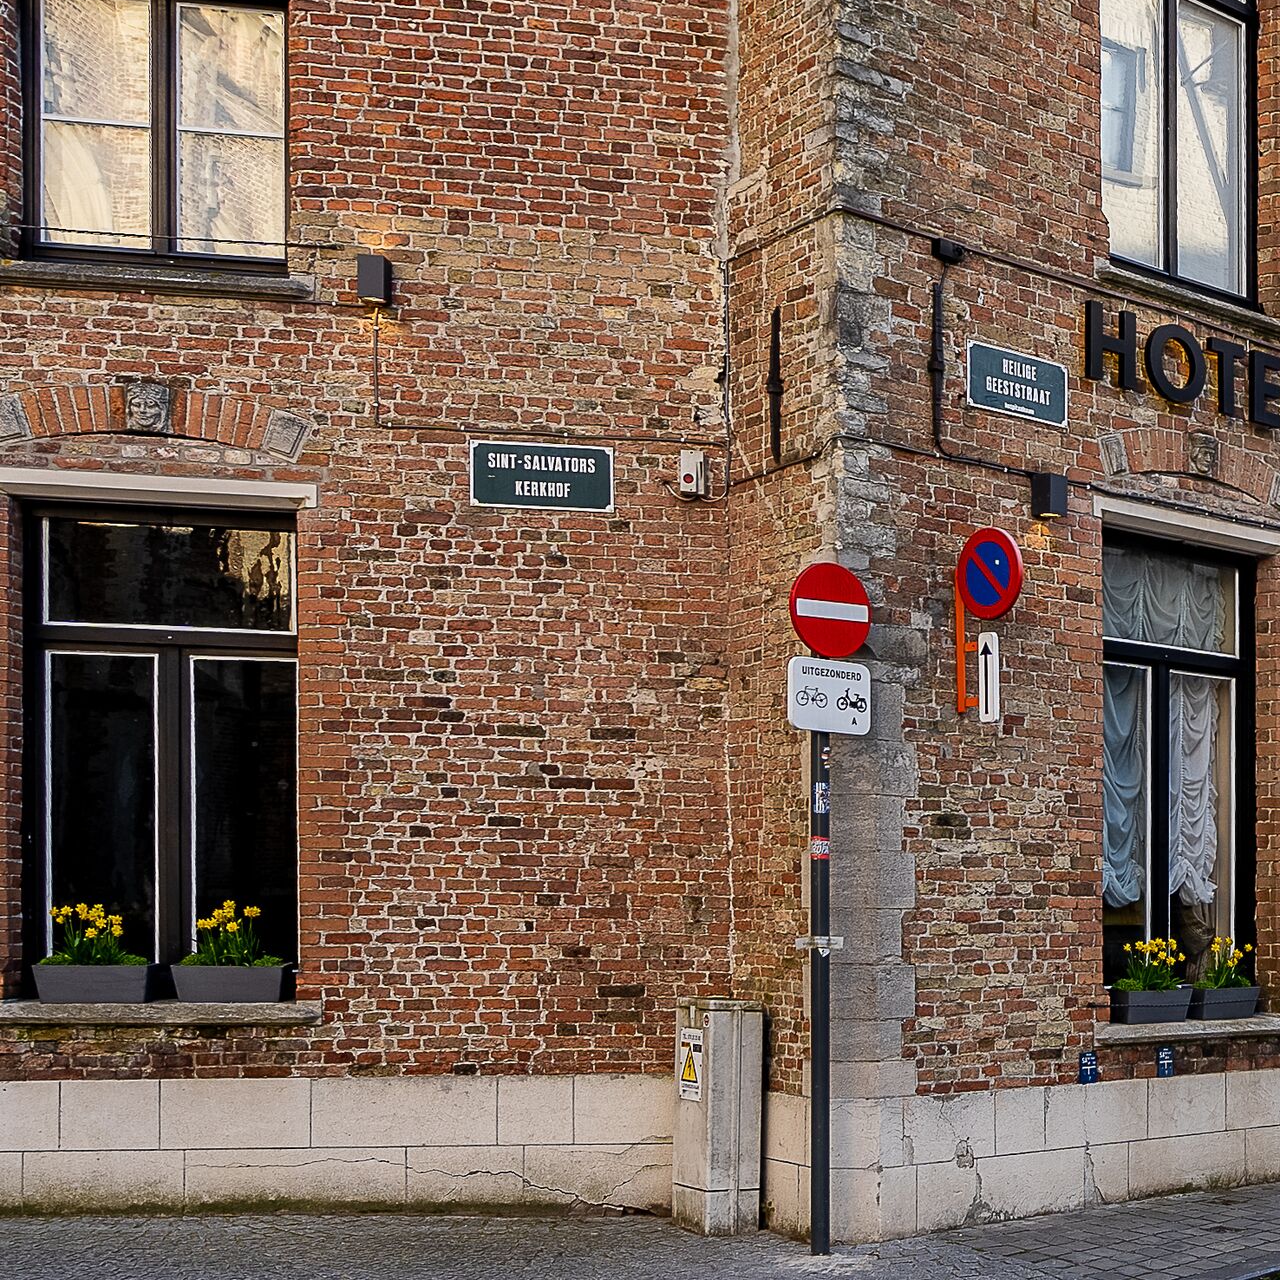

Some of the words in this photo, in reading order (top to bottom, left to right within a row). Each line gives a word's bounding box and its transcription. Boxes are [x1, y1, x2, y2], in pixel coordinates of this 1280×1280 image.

[1002, 358, 1037, 381] HEILIGE
[986, 376, 1051, 405] GEESTSTRAAT
[487, 452, 596, 473] SINT-SALVATORS
[515, 480, 571, 498] KERKHOF
[802, 665, 862, 681] UITGEZONDERD
[851, 717, 857, 726] A
